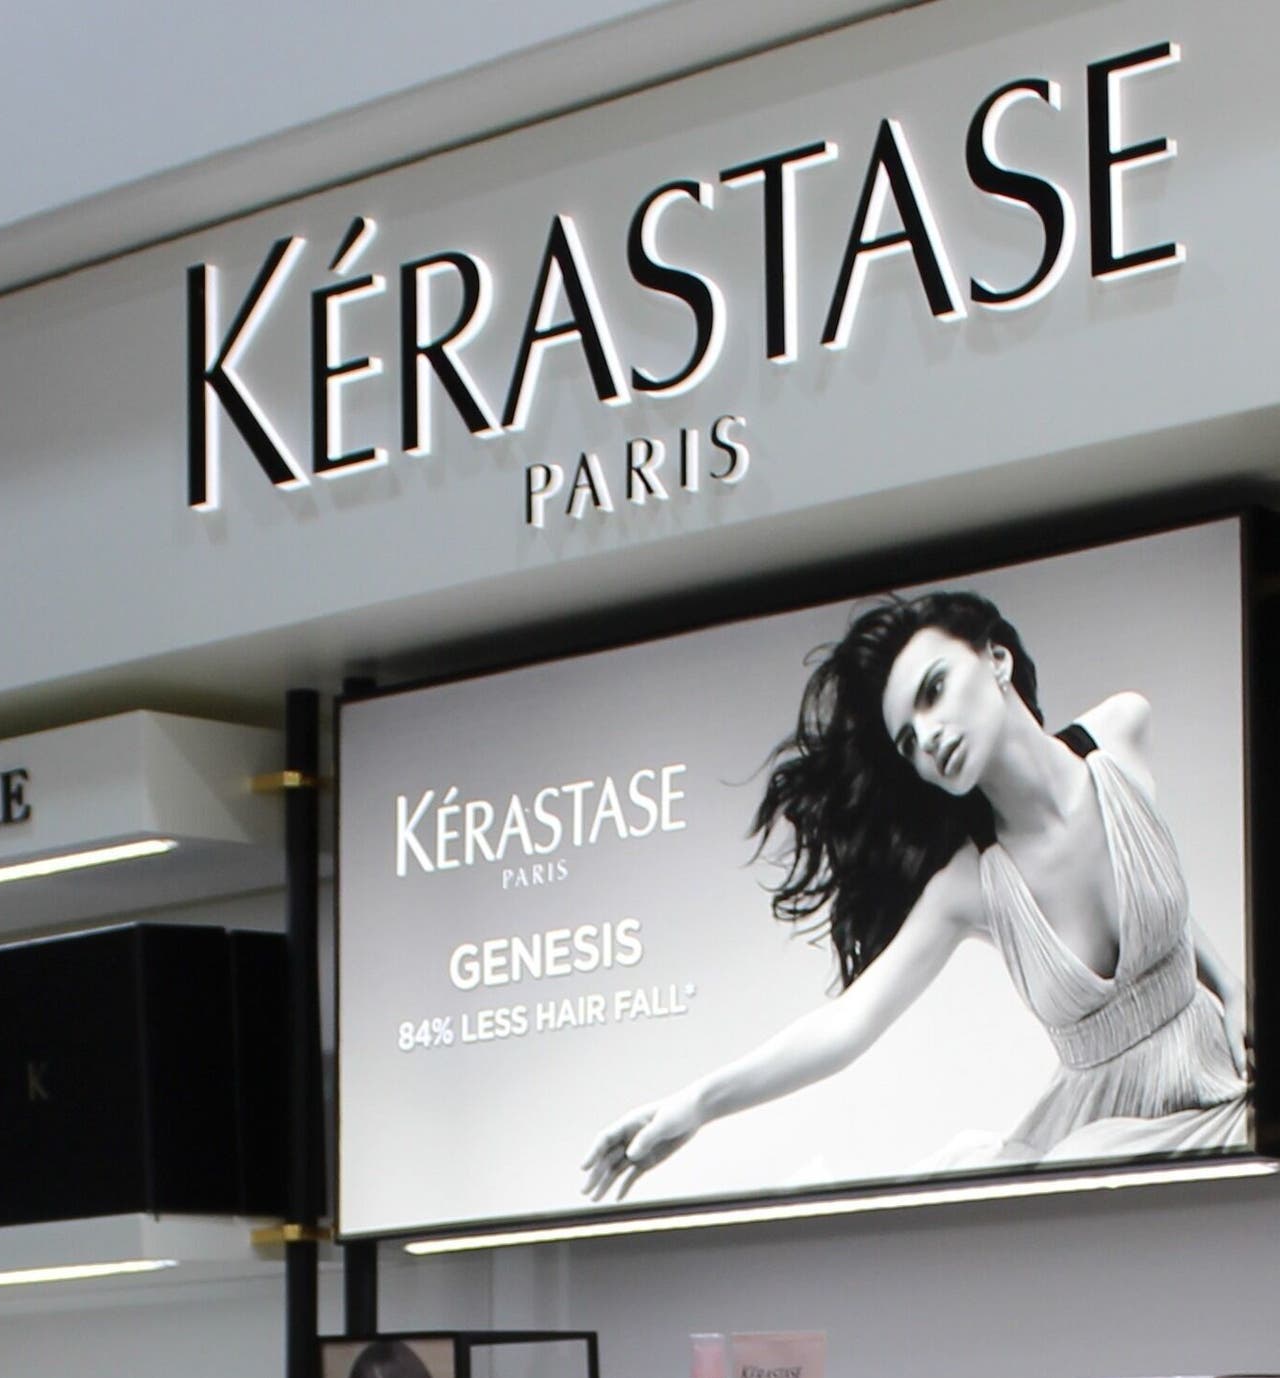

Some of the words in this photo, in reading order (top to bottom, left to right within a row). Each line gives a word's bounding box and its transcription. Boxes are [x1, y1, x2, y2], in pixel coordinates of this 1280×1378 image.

[187, 41, 1185, 511] KÉRASTASE
[525, 414, 750, 528] PARIS
[395, 763, 688, 877] KÉRASTASE
[502, 859, 570, 890] PARIS
[449, 917, 644, 991] GENESIS
[398, 1015, 455, 1051] 84%
[461, 1004, 528, 1043] LESS
[535, 993, 607, 1032] HAIR
